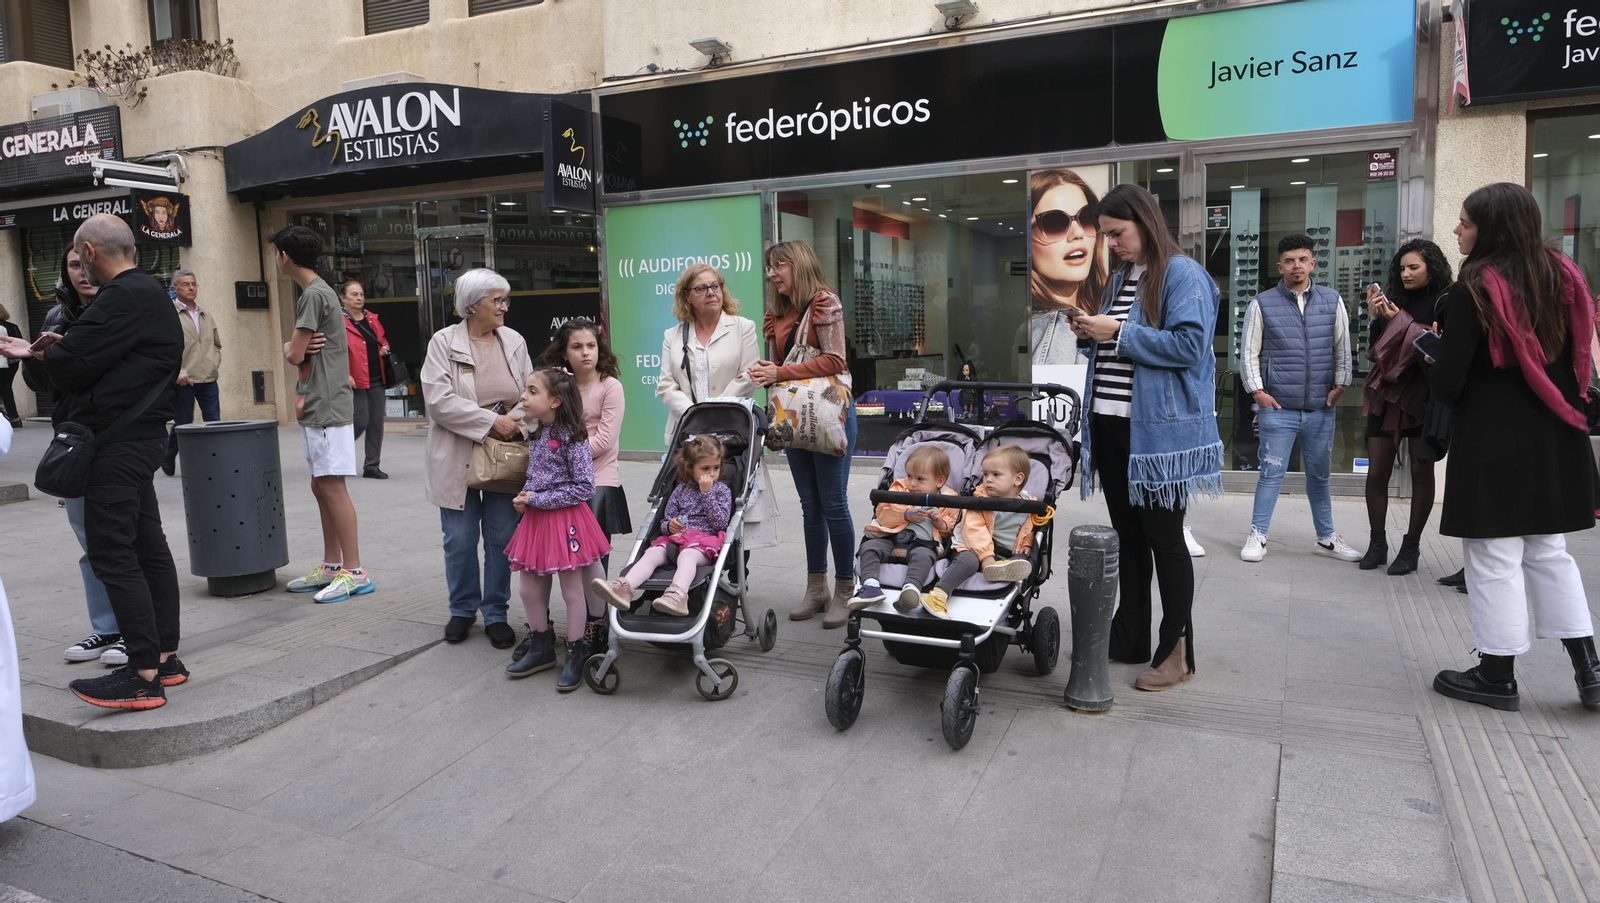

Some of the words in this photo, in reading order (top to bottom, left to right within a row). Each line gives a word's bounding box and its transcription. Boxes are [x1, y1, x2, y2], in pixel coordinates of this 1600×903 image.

[1208, 56, 1284, 89] Javier
[1291, 50, 1358, 74] Sanz
[326, 88, 461, 142] AVALON
[725, 96, 931, 144] federópticos
[2, 123, 100, 158] GENERALA
[344, 131, 440, 163] ESTILISTAS
[64, 151, 100, 166] cafebar
[557, 162, 592, 183] AVALON
[562, 177, 587, 190] ESTILISTAS
[53, 206, 69, 222] LA
[73, 199, 132, 218] GENERAL
[142, 226, 150, 235] LA
[150, 229, 182, 239] GENERALA
[638, 254, 731, 274] AUDIFONOS
[807, 389, 815, 400] les
[808, 402, 819, 444] meilleures
